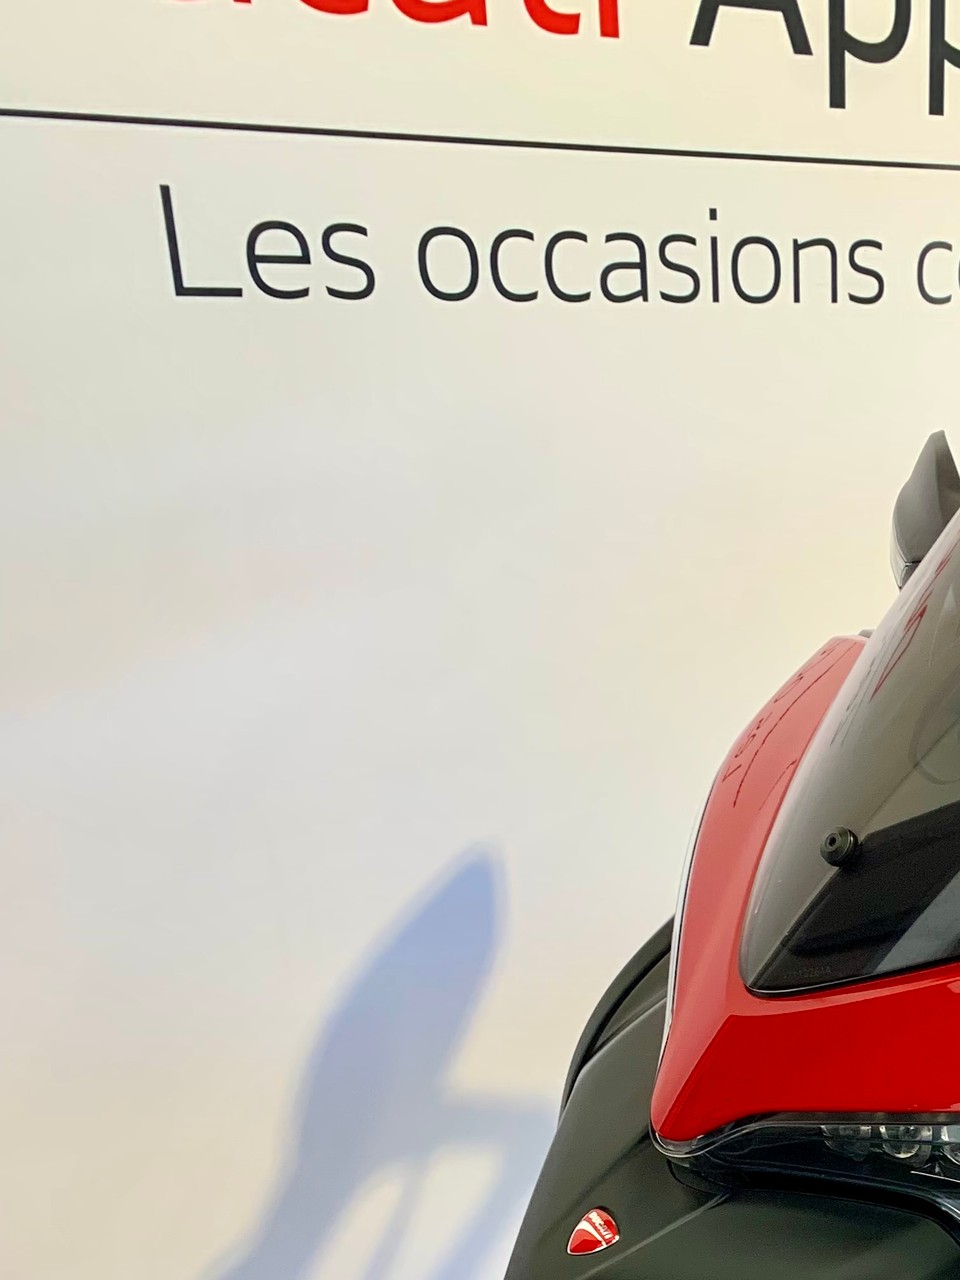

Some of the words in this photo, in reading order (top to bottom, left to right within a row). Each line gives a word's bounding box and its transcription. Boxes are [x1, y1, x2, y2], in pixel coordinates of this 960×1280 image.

[158, 183, 377, 300] Les
[416, 207, 886, 304] occasions
[588, 1211, 613, 1240] DUCATI
